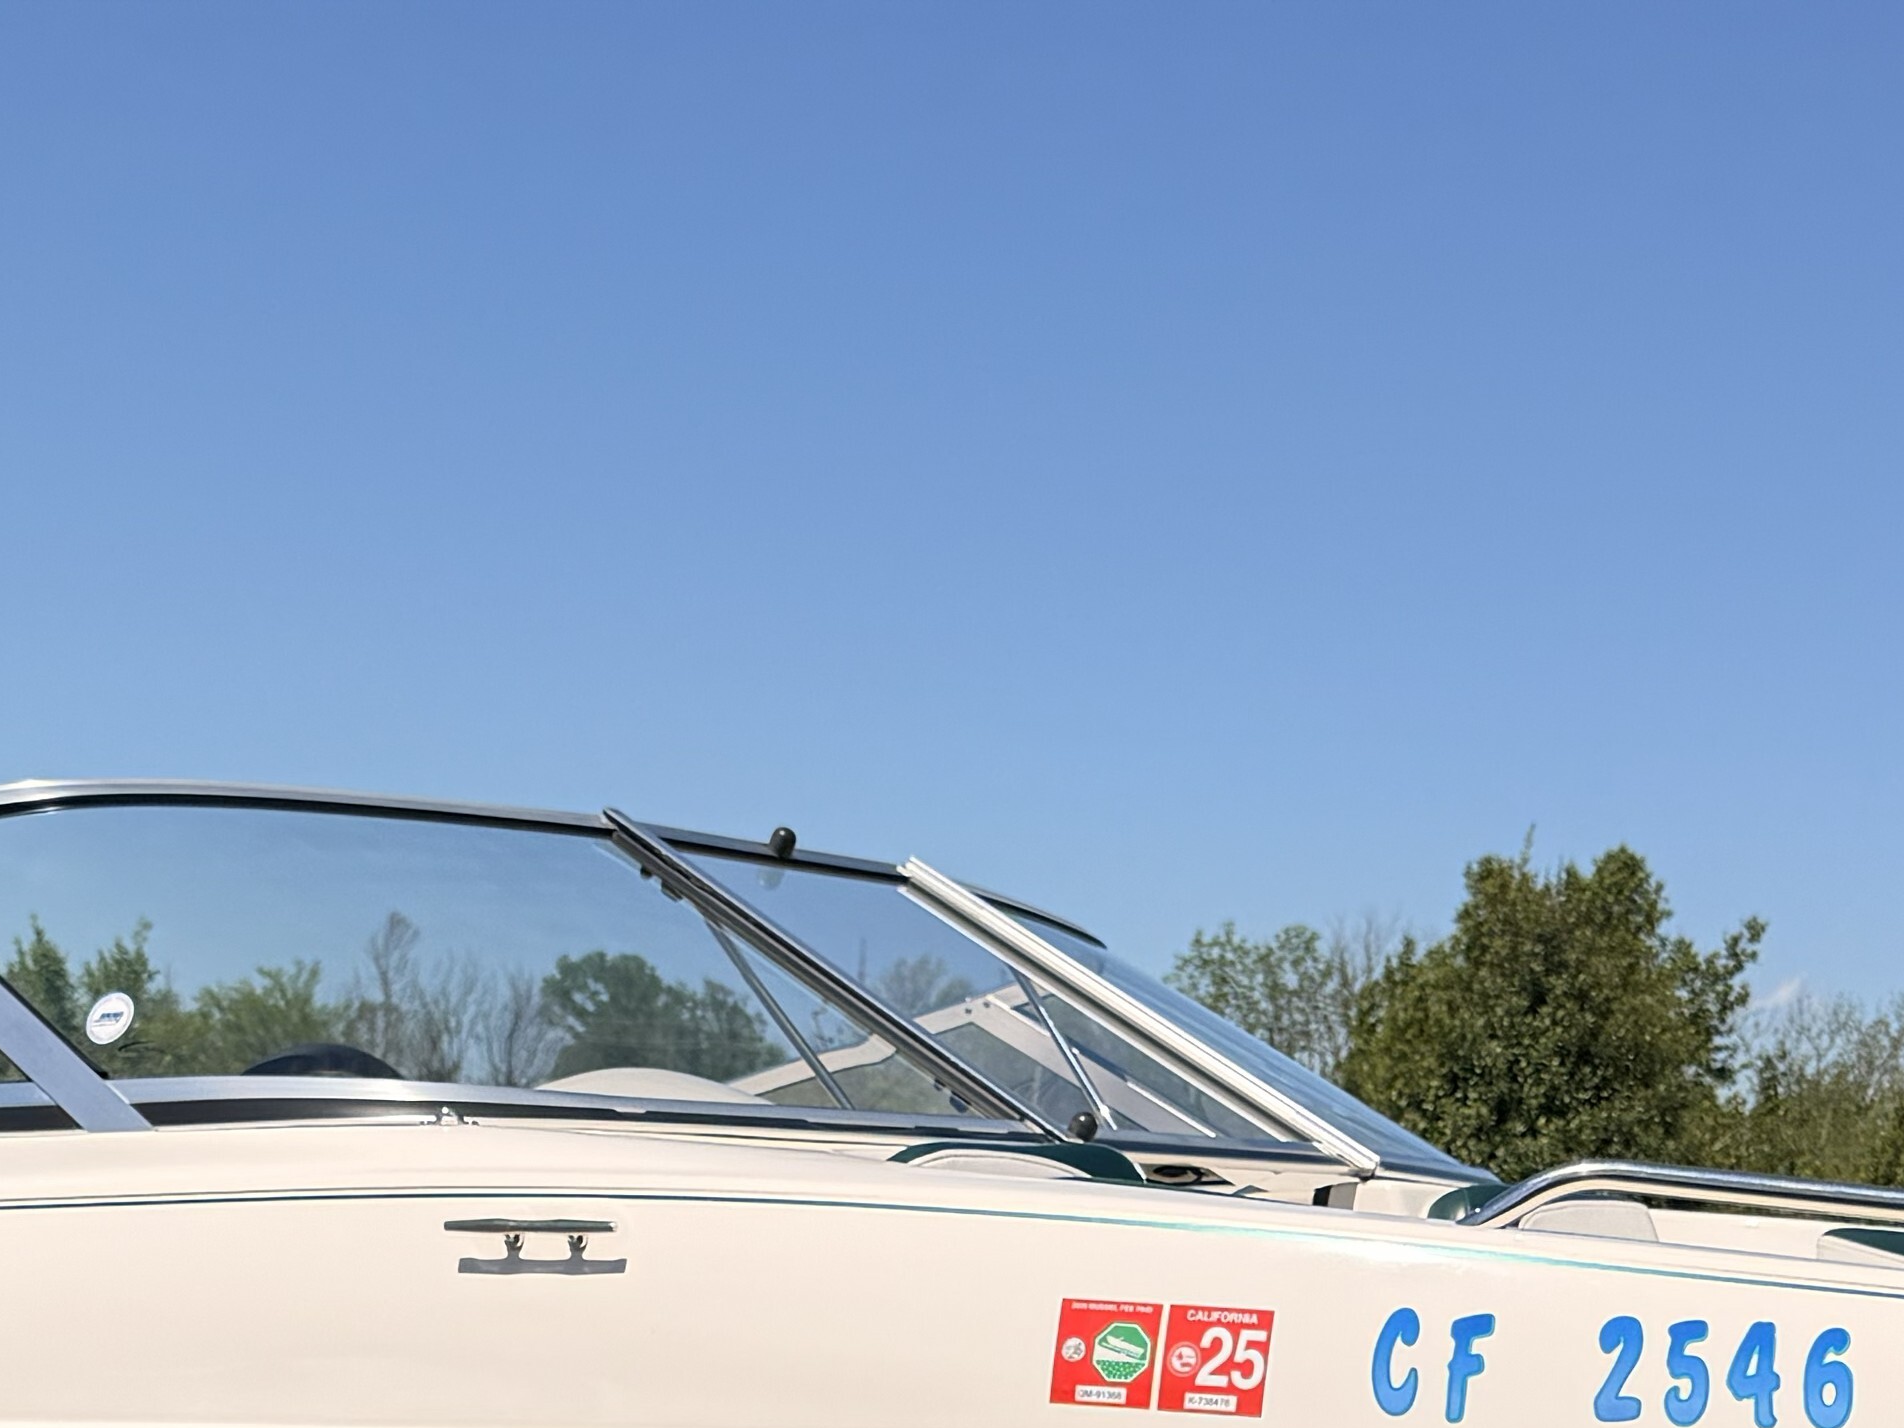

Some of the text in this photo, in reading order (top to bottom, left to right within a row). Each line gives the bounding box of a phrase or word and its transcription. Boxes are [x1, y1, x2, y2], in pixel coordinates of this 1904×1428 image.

[1186, 1309, 1259, 1325] CALIFORNIA
[1194, 1326, 1269, 1391] 25
[1371, 1306, 1496, 1424] CF
